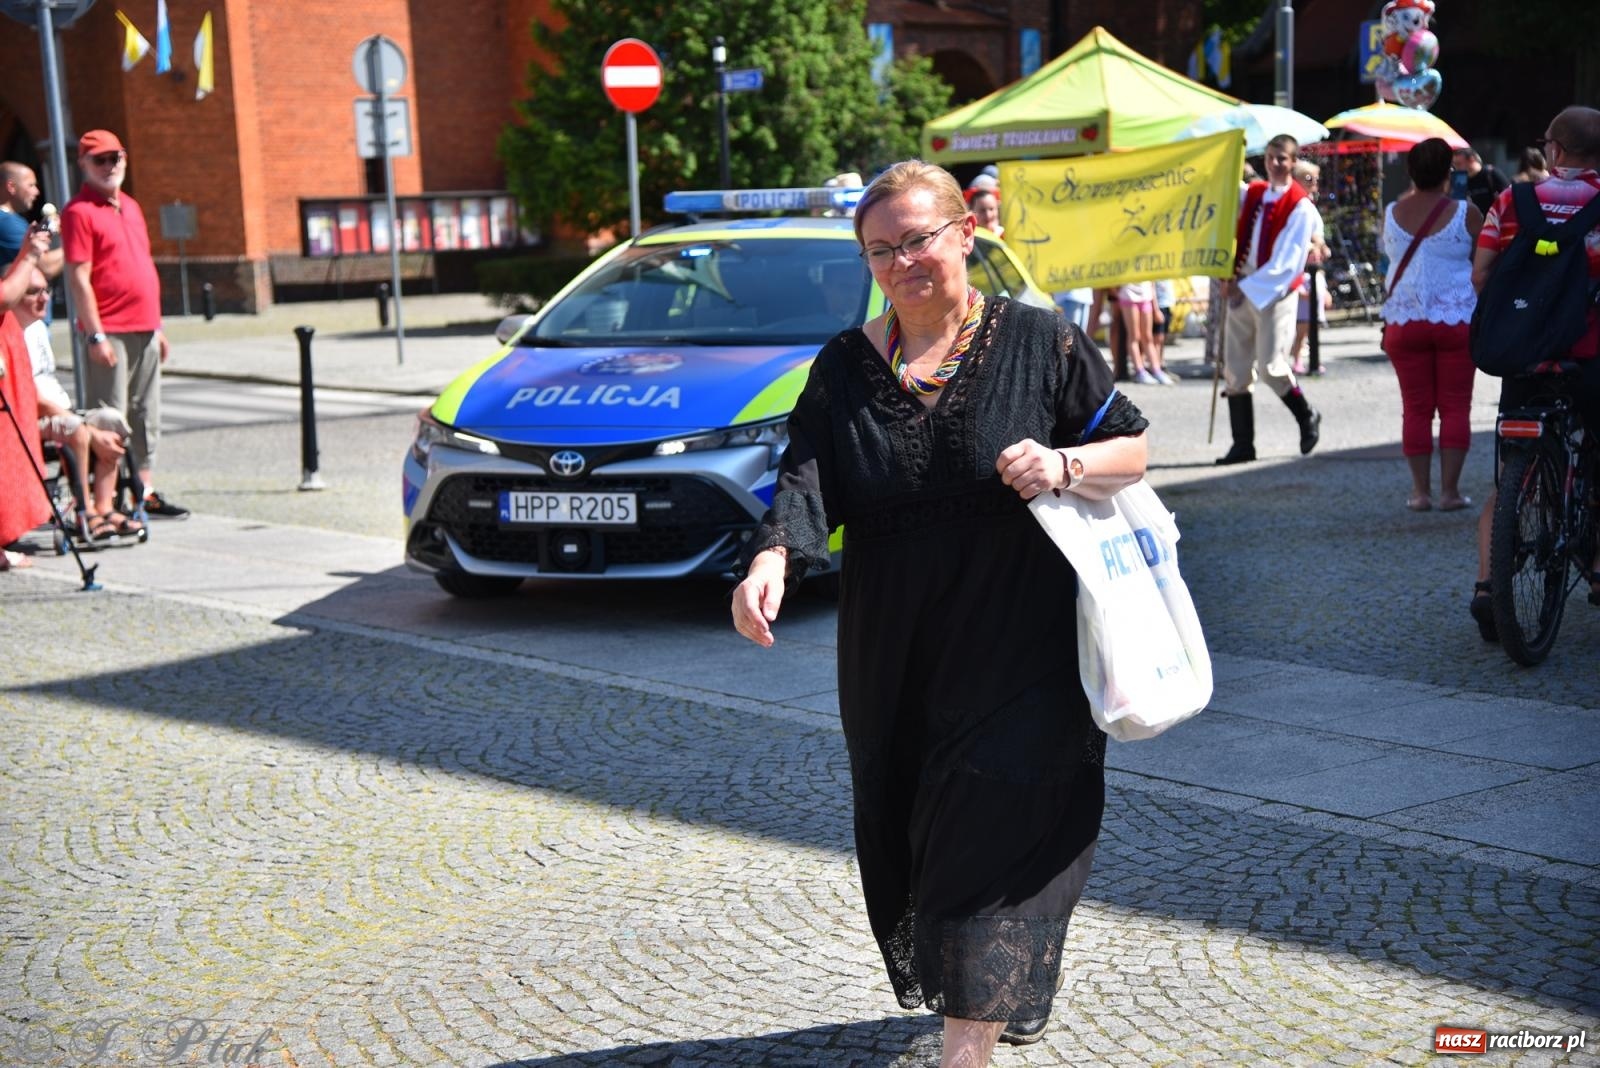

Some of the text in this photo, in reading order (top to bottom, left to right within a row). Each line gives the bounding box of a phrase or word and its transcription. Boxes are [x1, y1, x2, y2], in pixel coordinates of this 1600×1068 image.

[741, 192, 807, 209] POLICJA
[505, 384, 680, 409] POLICJA
[515, 495, 629, 521] HPP R205
